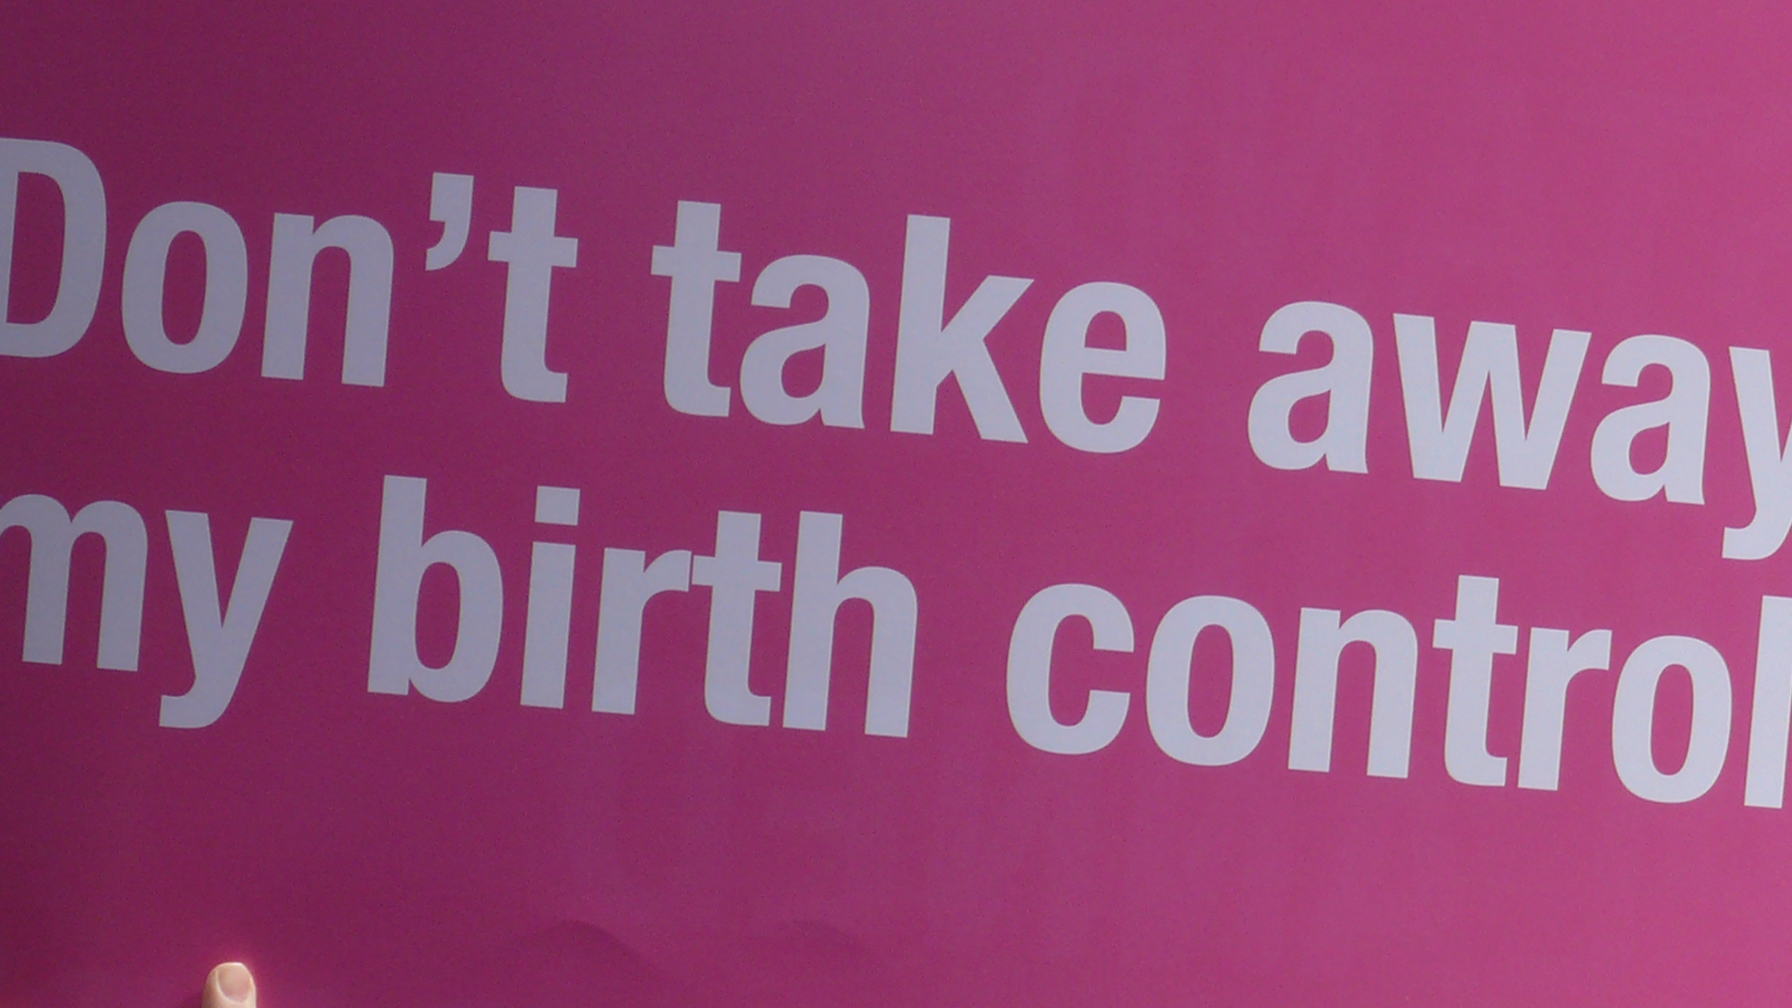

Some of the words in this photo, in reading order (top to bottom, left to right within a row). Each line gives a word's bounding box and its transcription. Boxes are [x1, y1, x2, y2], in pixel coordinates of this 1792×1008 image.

[0, 137, 579, 403] Don’t
[651, 200, 1167, 453] take
[0, 494, 293, 728] my
[368, 475, 918, 738] birth
